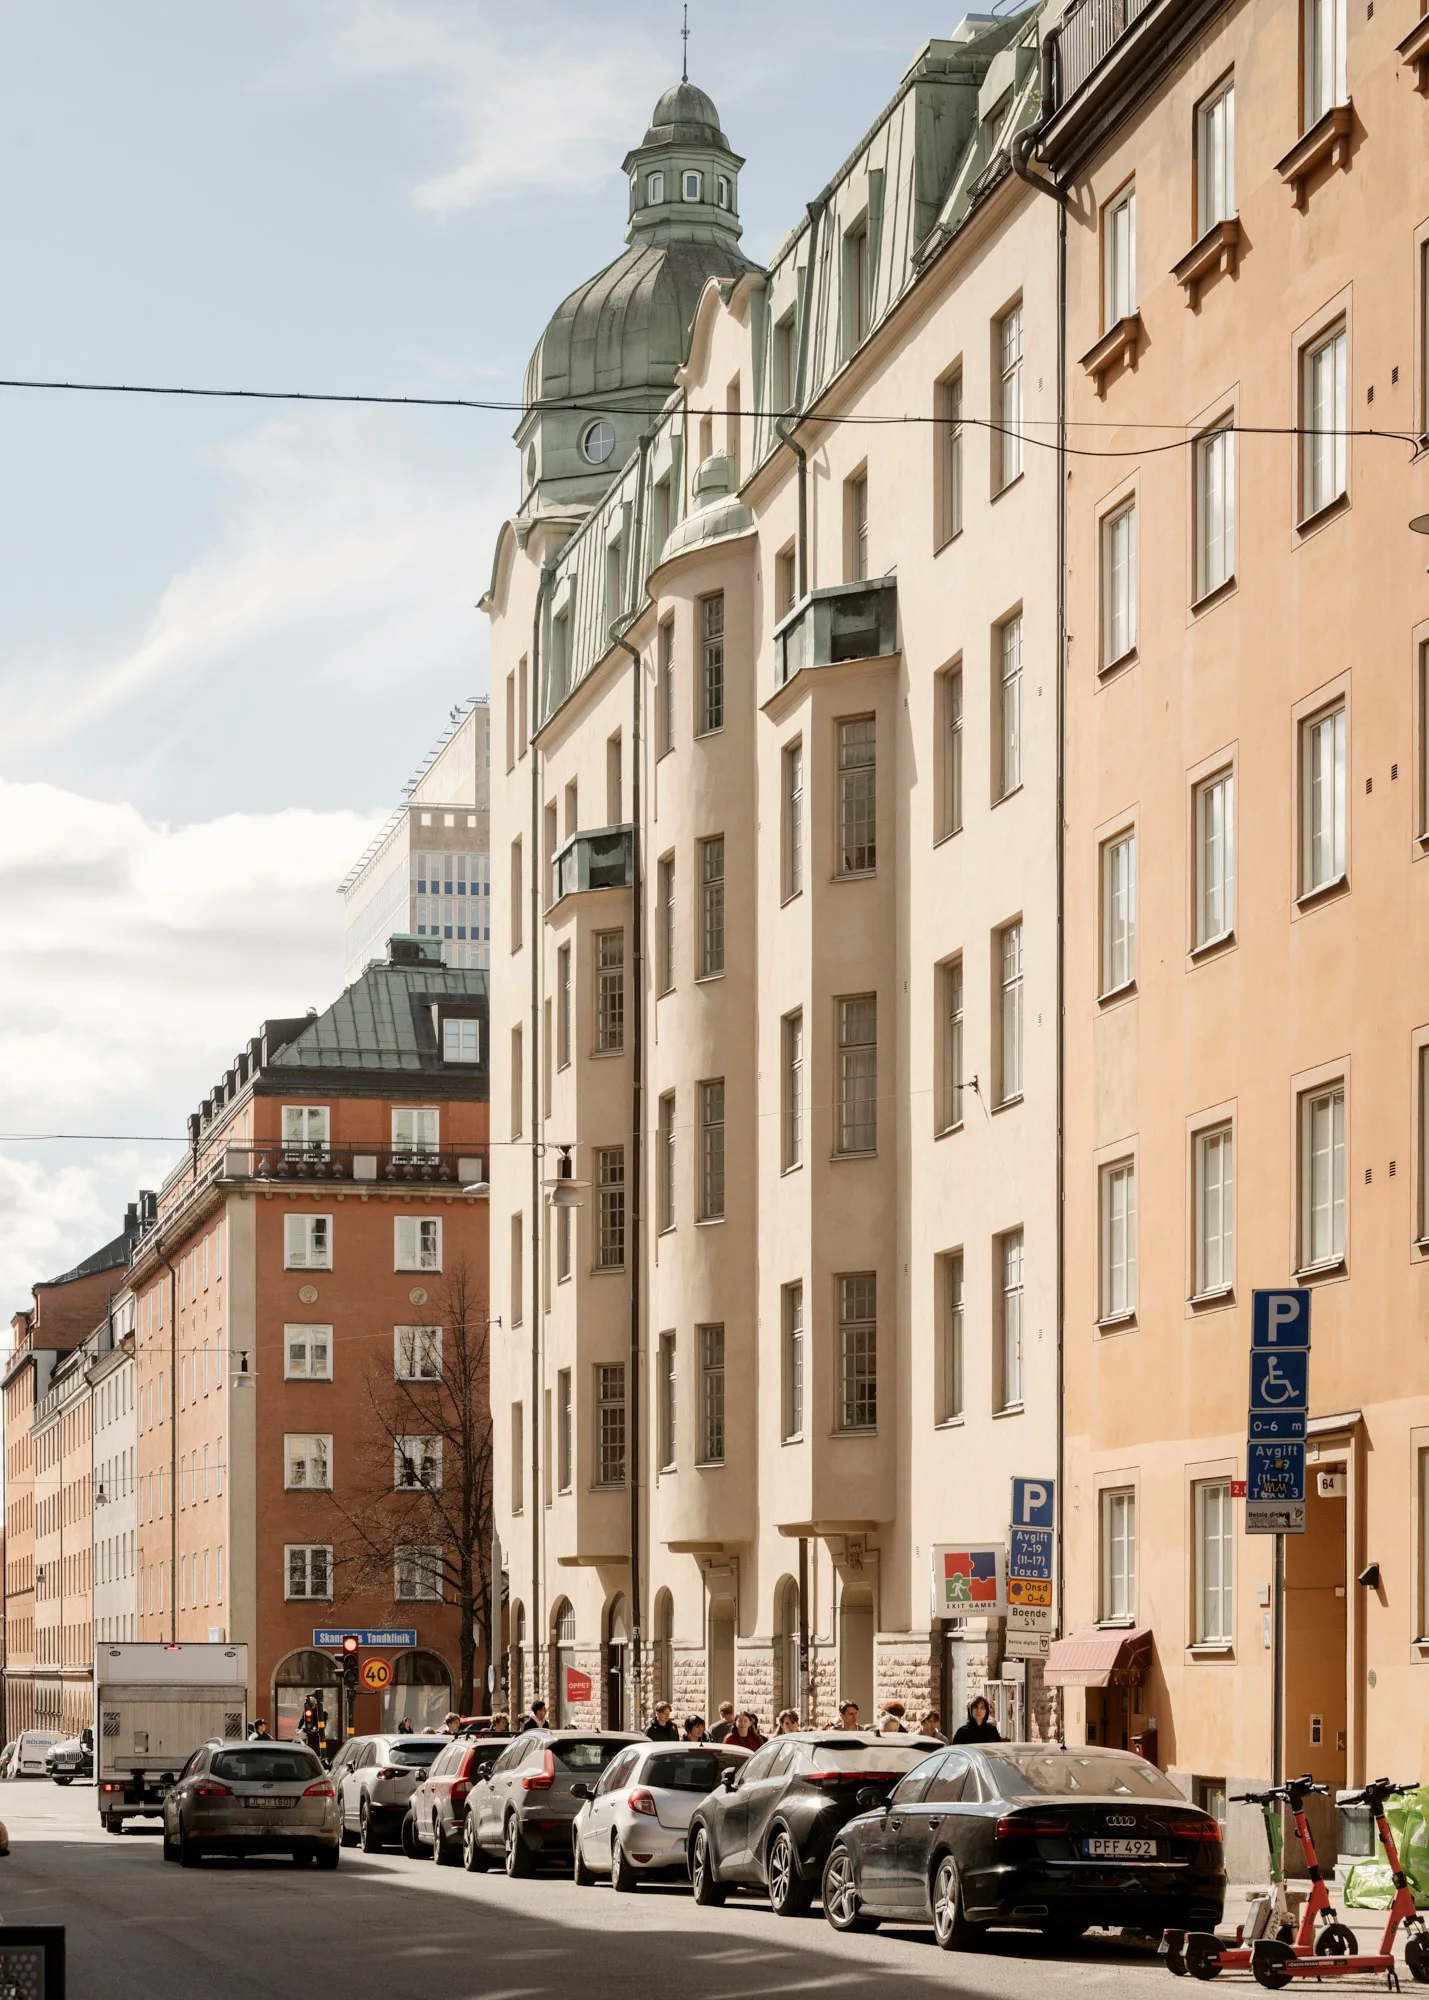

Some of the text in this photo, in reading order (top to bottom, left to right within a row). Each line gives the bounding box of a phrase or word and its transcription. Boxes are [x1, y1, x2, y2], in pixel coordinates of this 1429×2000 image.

[1267, 1295, 1300, 1342] P
[1253, 1421, 1302, 1432] 0-6 m
[1256, 1445, 1297, 1458] Avgift
[1262, 1459, 1290, 1470] 7-9
[1322, 1478, 1334, 1490] 64
[1291, 1487, 1299, 1498] 3
[1023, 1483, 1047, 1522] P
[1016, 1531, 1048, 1543] Avgift
[1021, 1543, 1042, 1553] 7-19
[1017, 1555, 1045, 1566] (11-17)
[1013, 1566, 1048, 1577] Taxa 3
[1025, 1582, 1048, 1592] Onsd
[1027, 1593, 1045, 1603] 0-6
[1012, 1607, 1047, 1618] Boende
[367, 1632, 410, 1644] Tandklinik
[365, 1666, 388, 1682] 40
[1093, 1840, 1152, 1854] PFF 492
